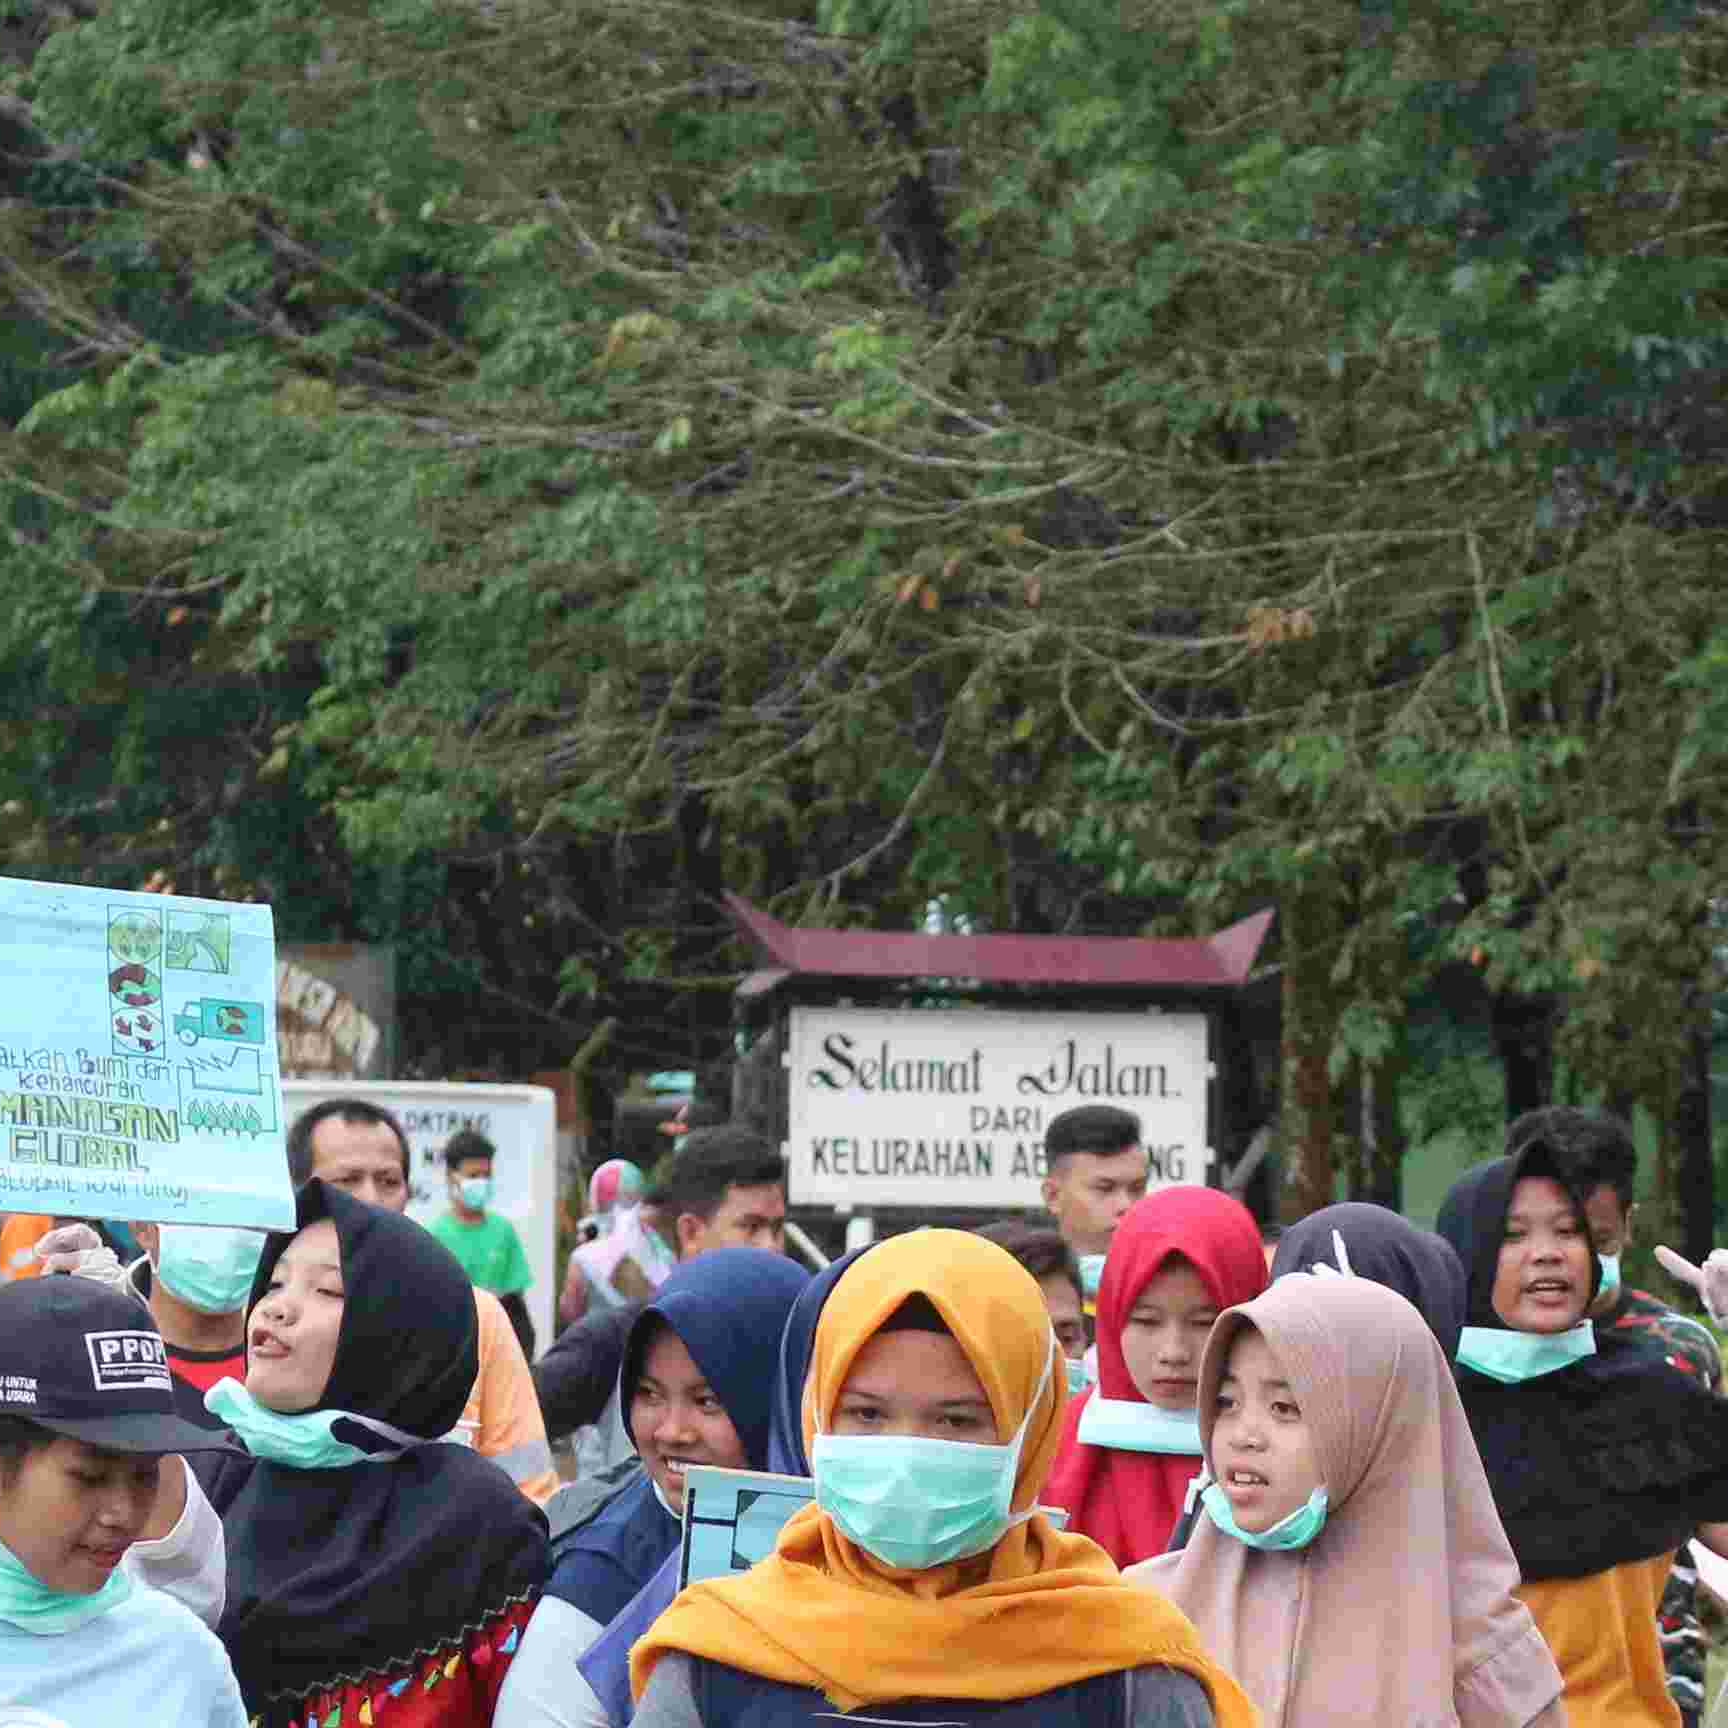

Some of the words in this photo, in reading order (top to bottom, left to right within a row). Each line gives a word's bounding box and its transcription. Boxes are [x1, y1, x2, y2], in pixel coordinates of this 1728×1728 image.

[75, 1048, 130, 1081] Bumi
[807, 1032, 984, 1095] Selamat
[971, 1106, 1041, 1133] DARI
[9, 1128, 151, 1173] GLOBAL
[812, 1137, 992, 1178] KELURAHAN
